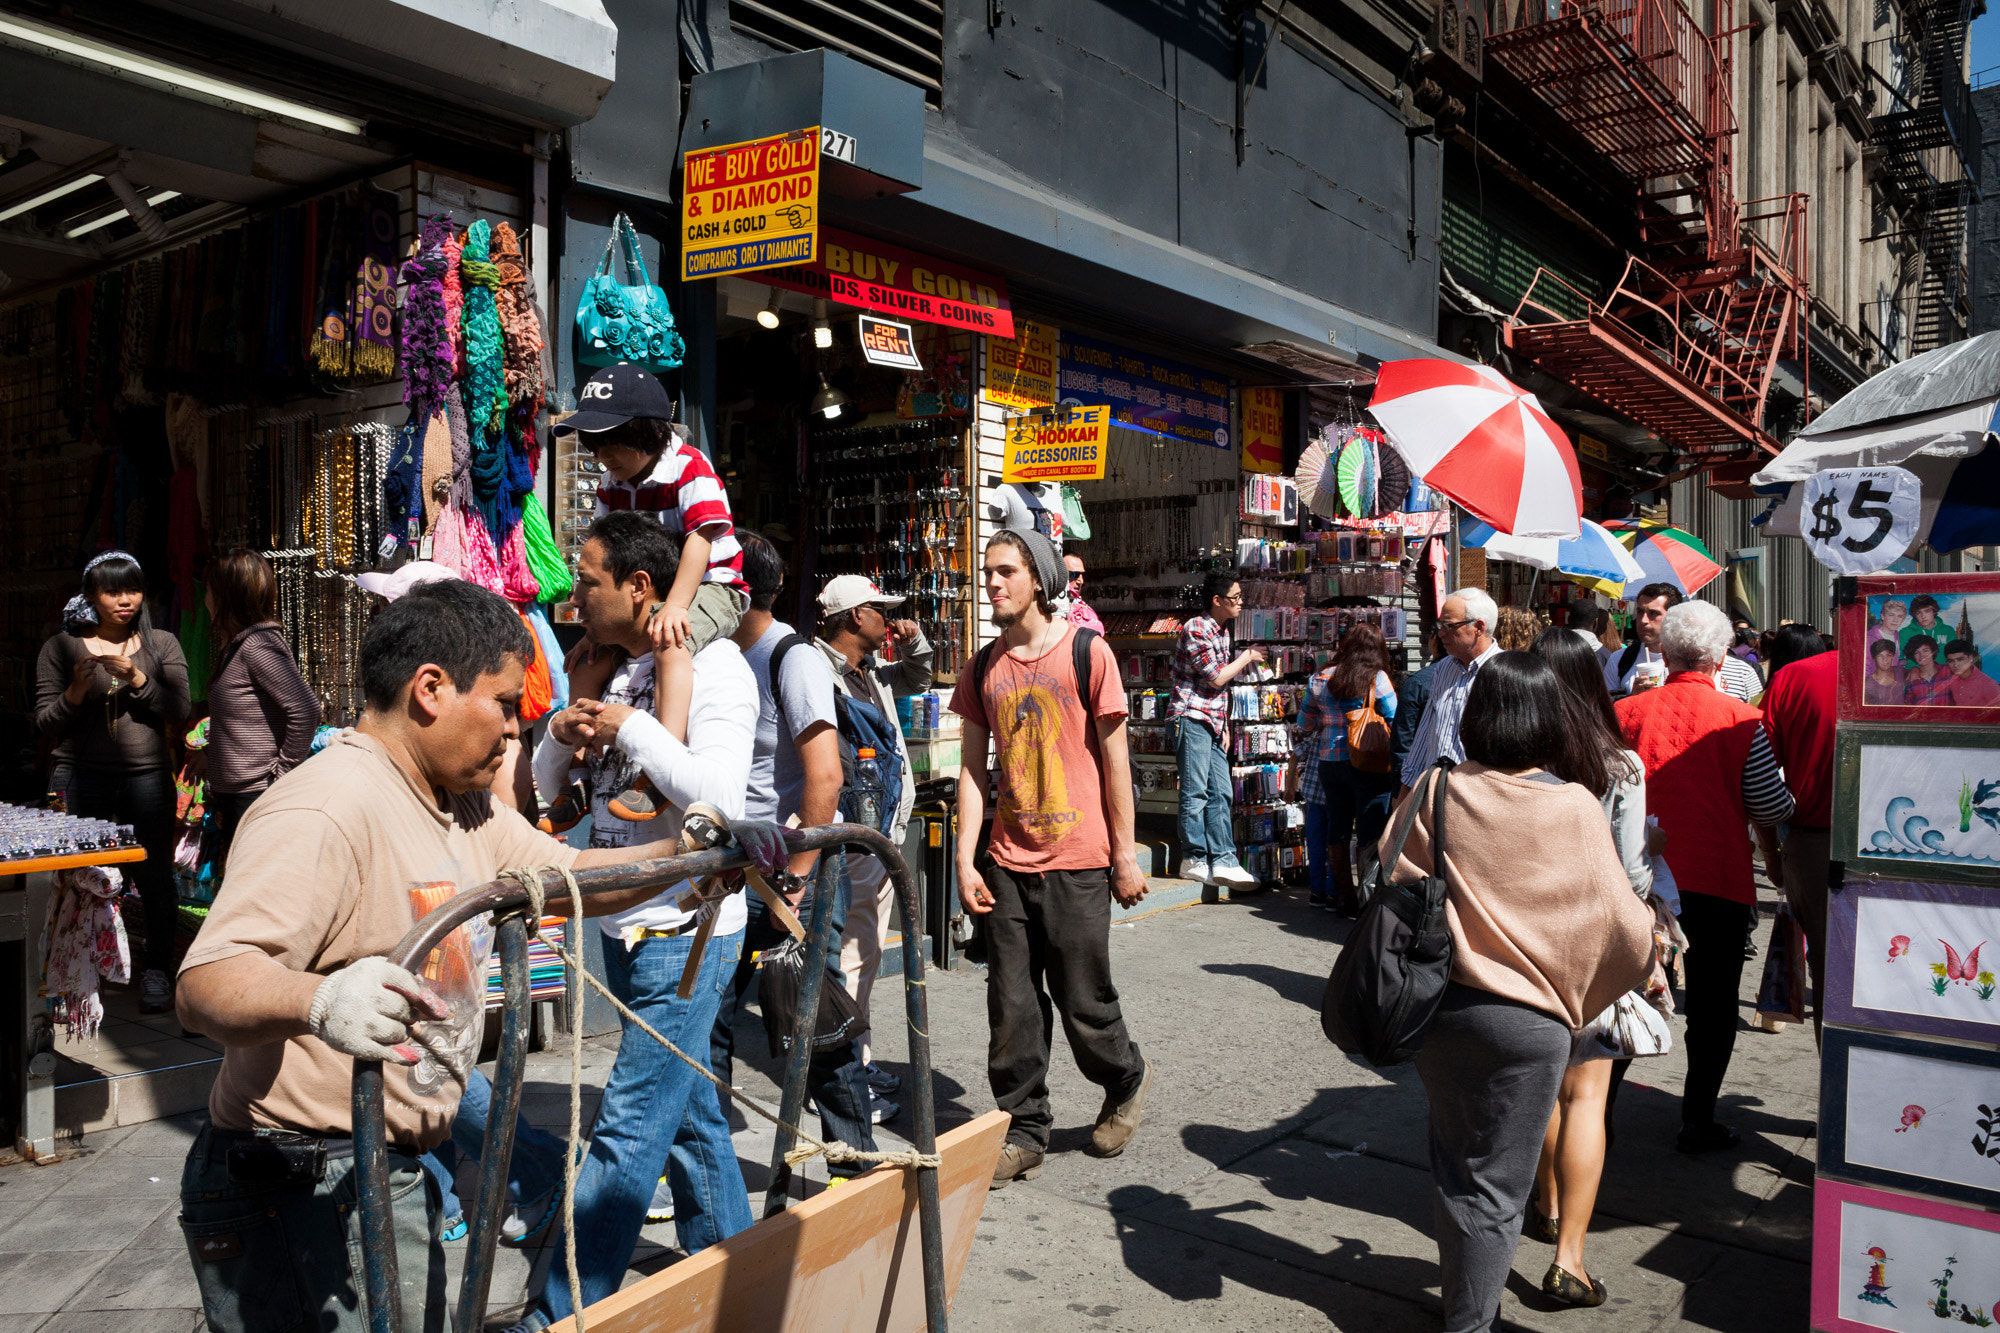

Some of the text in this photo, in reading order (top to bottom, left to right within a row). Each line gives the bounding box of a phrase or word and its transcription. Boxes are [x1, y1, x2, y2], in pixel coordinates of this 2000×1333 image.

[823, 131, 856, 162] 271
[690, 138, 813, 187] WE BUY GOLD
[688, 175, 812, 218] & DIAMOND
[688, 214, 766, 240] CASH 4 GOLD
[688, 237, 810, 273] COMPRAMOS ORO Y DIAMANTE
[824, 242, 999, 310] BUY GOLD
[868, 286, 935, 317] SILVER,
[940, 303, 995, 328] COINS
[873, 324, 897, 338] FOR
[1014, 319, 1040, 335] ohn
[863, 333, 910, 355] RENT
[1060, 343, 1071, 360] NY
[994, 348, 1050, 376] REPAIR
[580, 381, 613, 400] YC
[992, 368, 1052, 394] CHANGE BATTERY
[1061, 369, 1098, 393] LUGGAGE
[1036, 426, 1099, 445] HOOKAH
[1175, 425, 1213, 443] HIGHLIGHTS
[1013, 446, 1098, 465] ACCESSORIES
[1046, 467, 1061, 475] CANAL
[1829, 471, 1890, 480] EACH NAME
